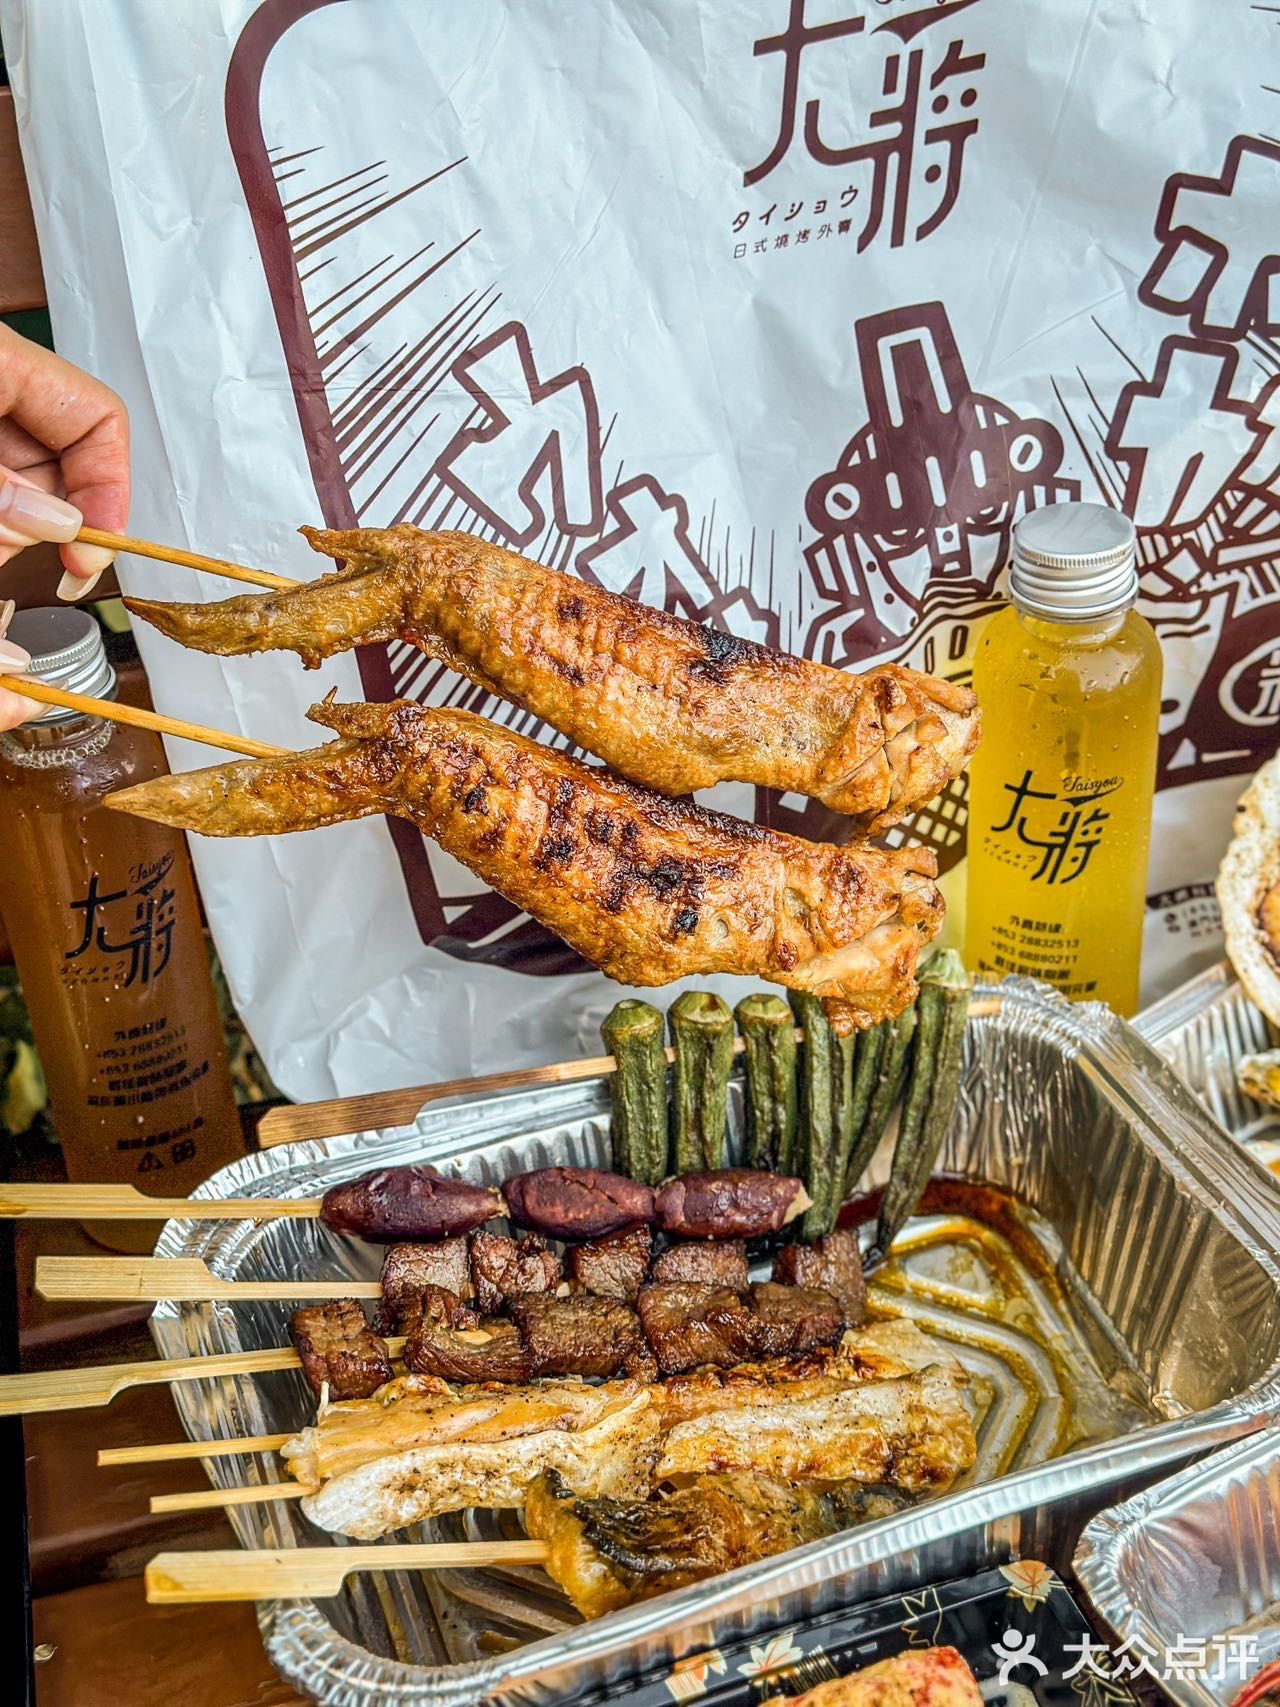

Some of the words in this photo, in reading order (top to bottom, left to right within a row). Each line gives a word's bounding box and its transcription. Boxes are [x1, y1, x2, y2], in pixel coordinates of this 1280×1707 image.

[732, 185, 858, 233] タイショウ
